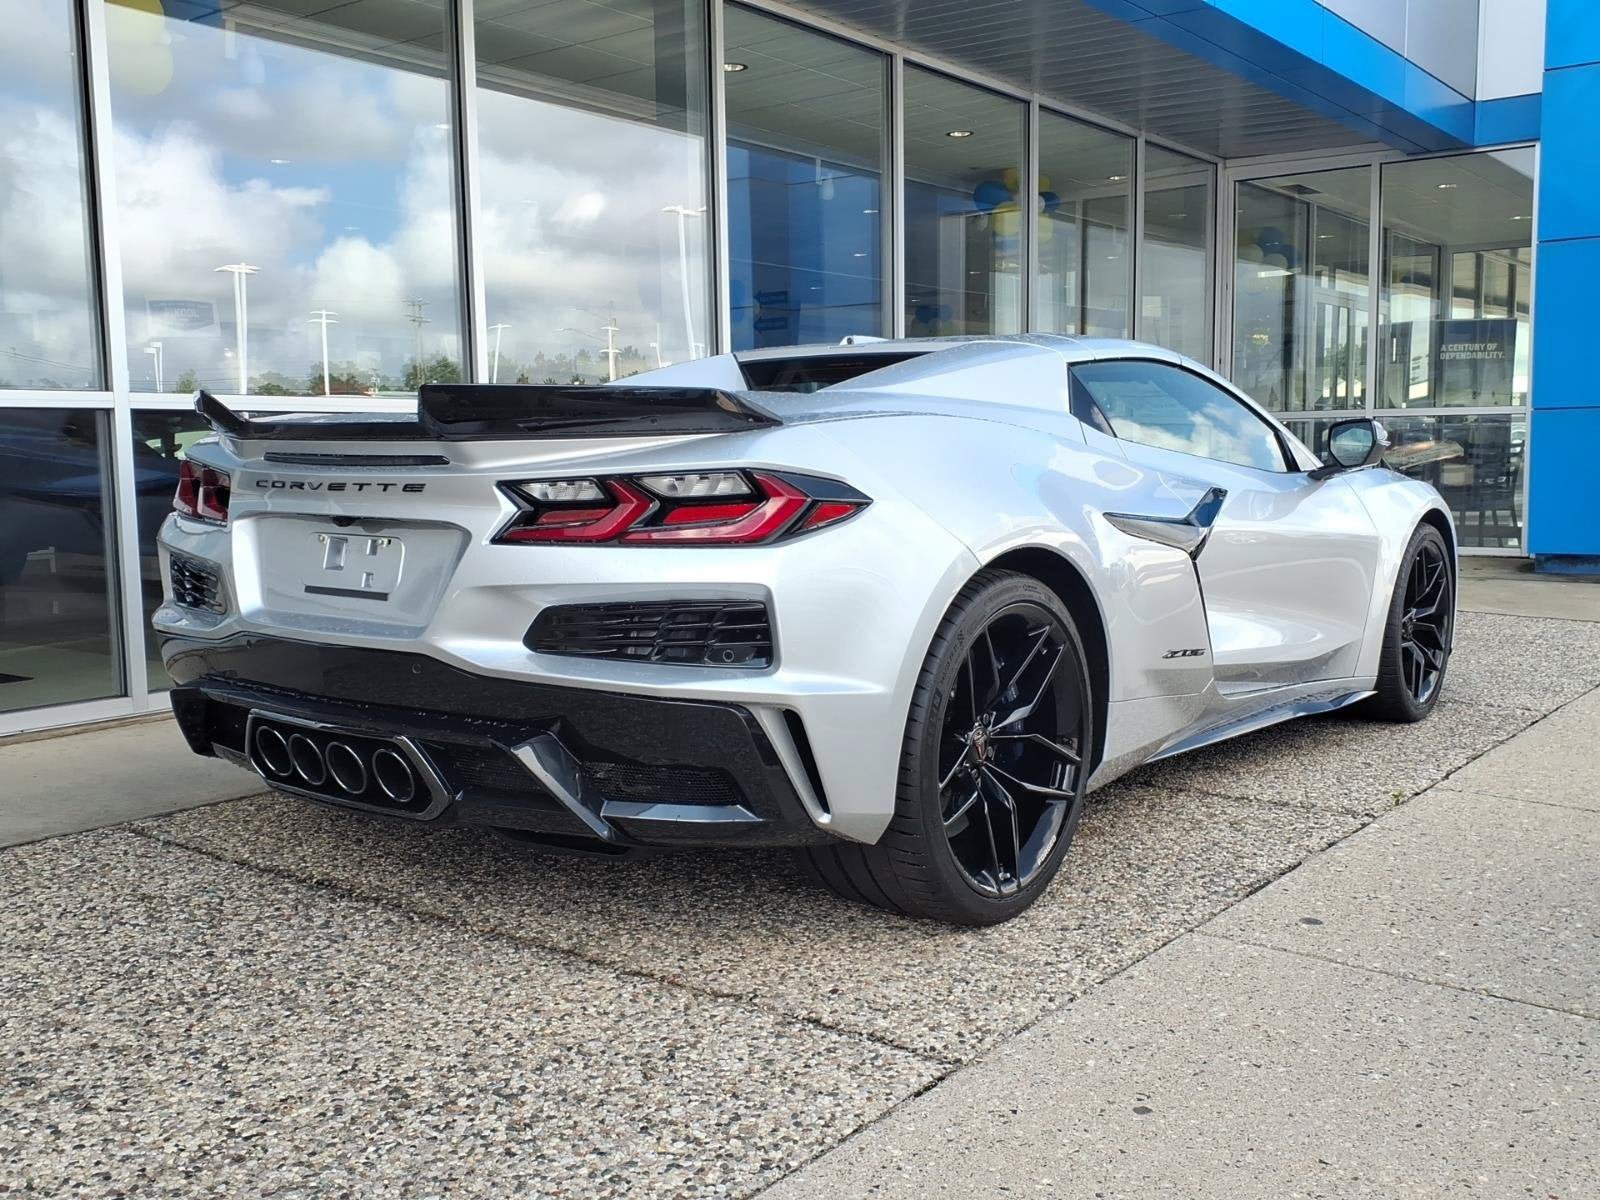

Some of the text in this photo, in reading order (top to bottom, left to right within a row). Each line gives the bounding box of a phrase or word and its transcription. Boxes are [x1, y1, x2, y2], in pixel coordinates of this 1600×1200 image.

[1440, 342, 1498, 352] A CENTURY OF
[1440, 351, 1505, 360] DEPENDABILITY.
[255, 479, 427, 493] CORVETTE
